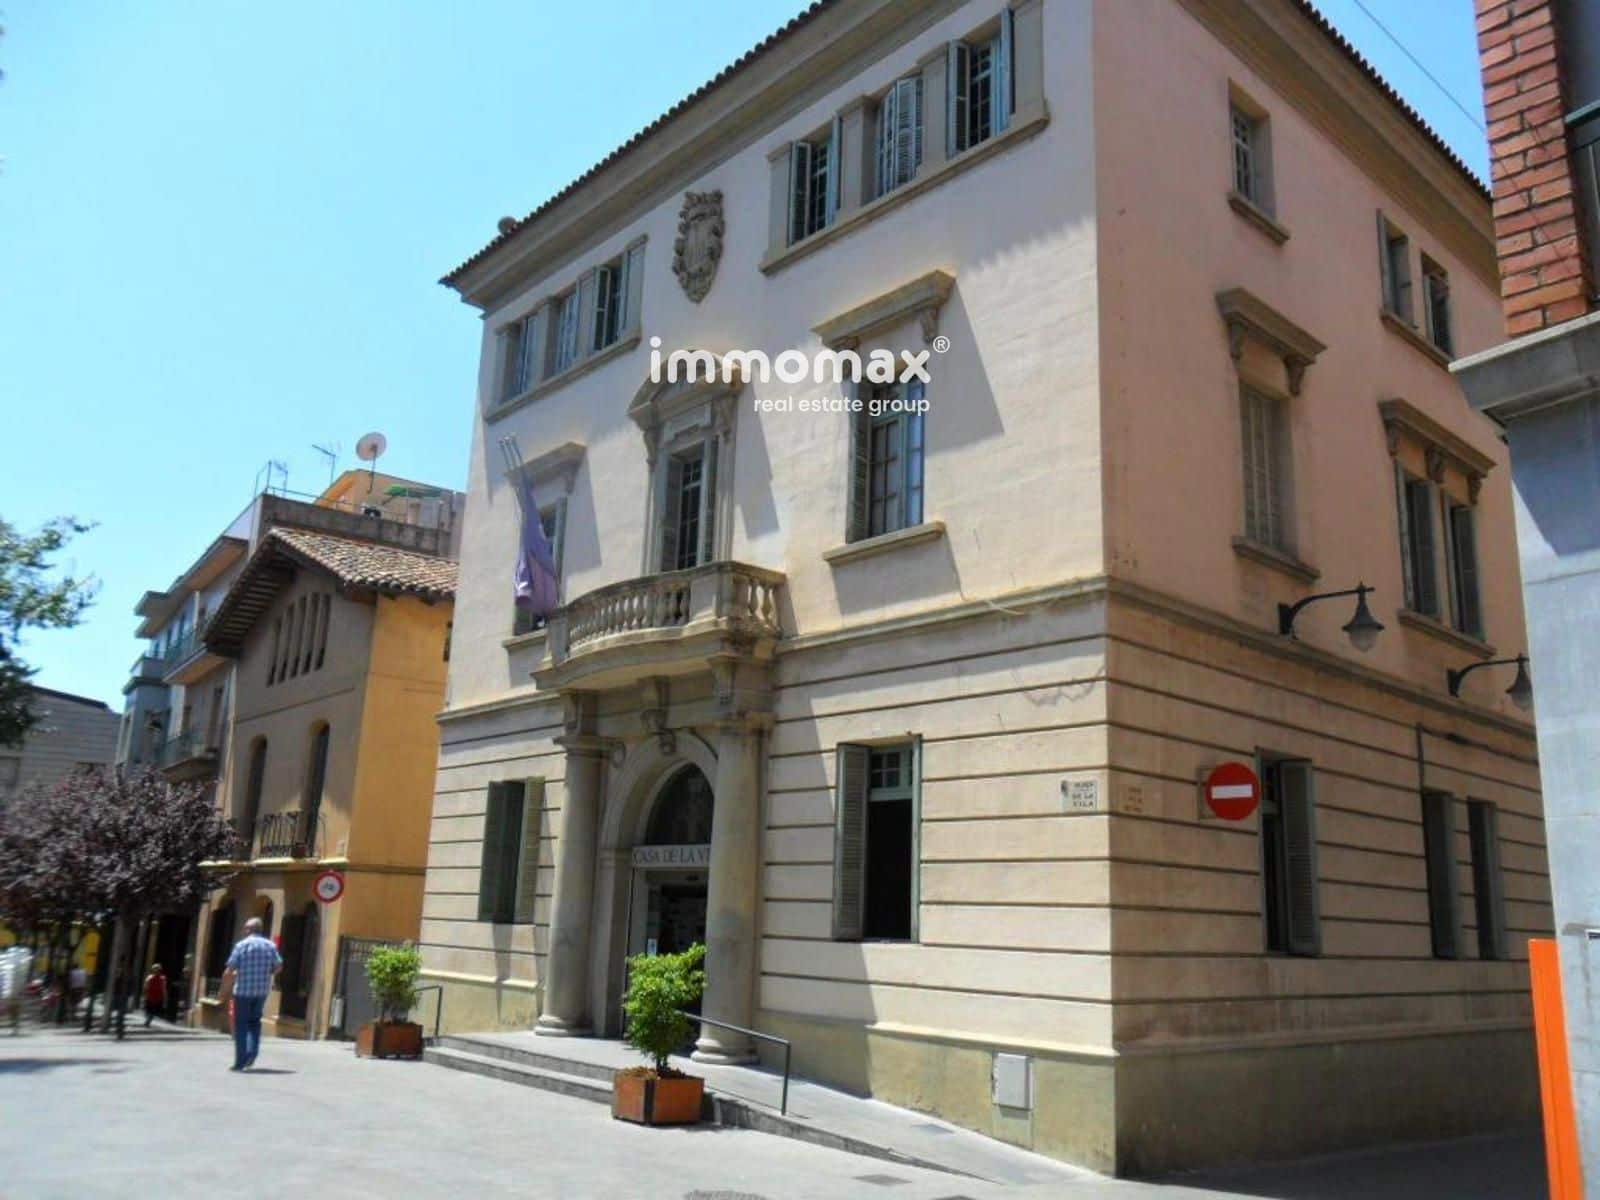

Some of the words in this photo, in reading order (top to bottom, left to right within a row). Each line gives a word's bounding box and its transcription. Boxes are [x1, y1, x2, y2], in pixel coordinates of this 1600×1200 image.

[632, 848, 660, 864] CASA
[663, 848, 680, 864] DE
[680, 847, 696, 864] LA
